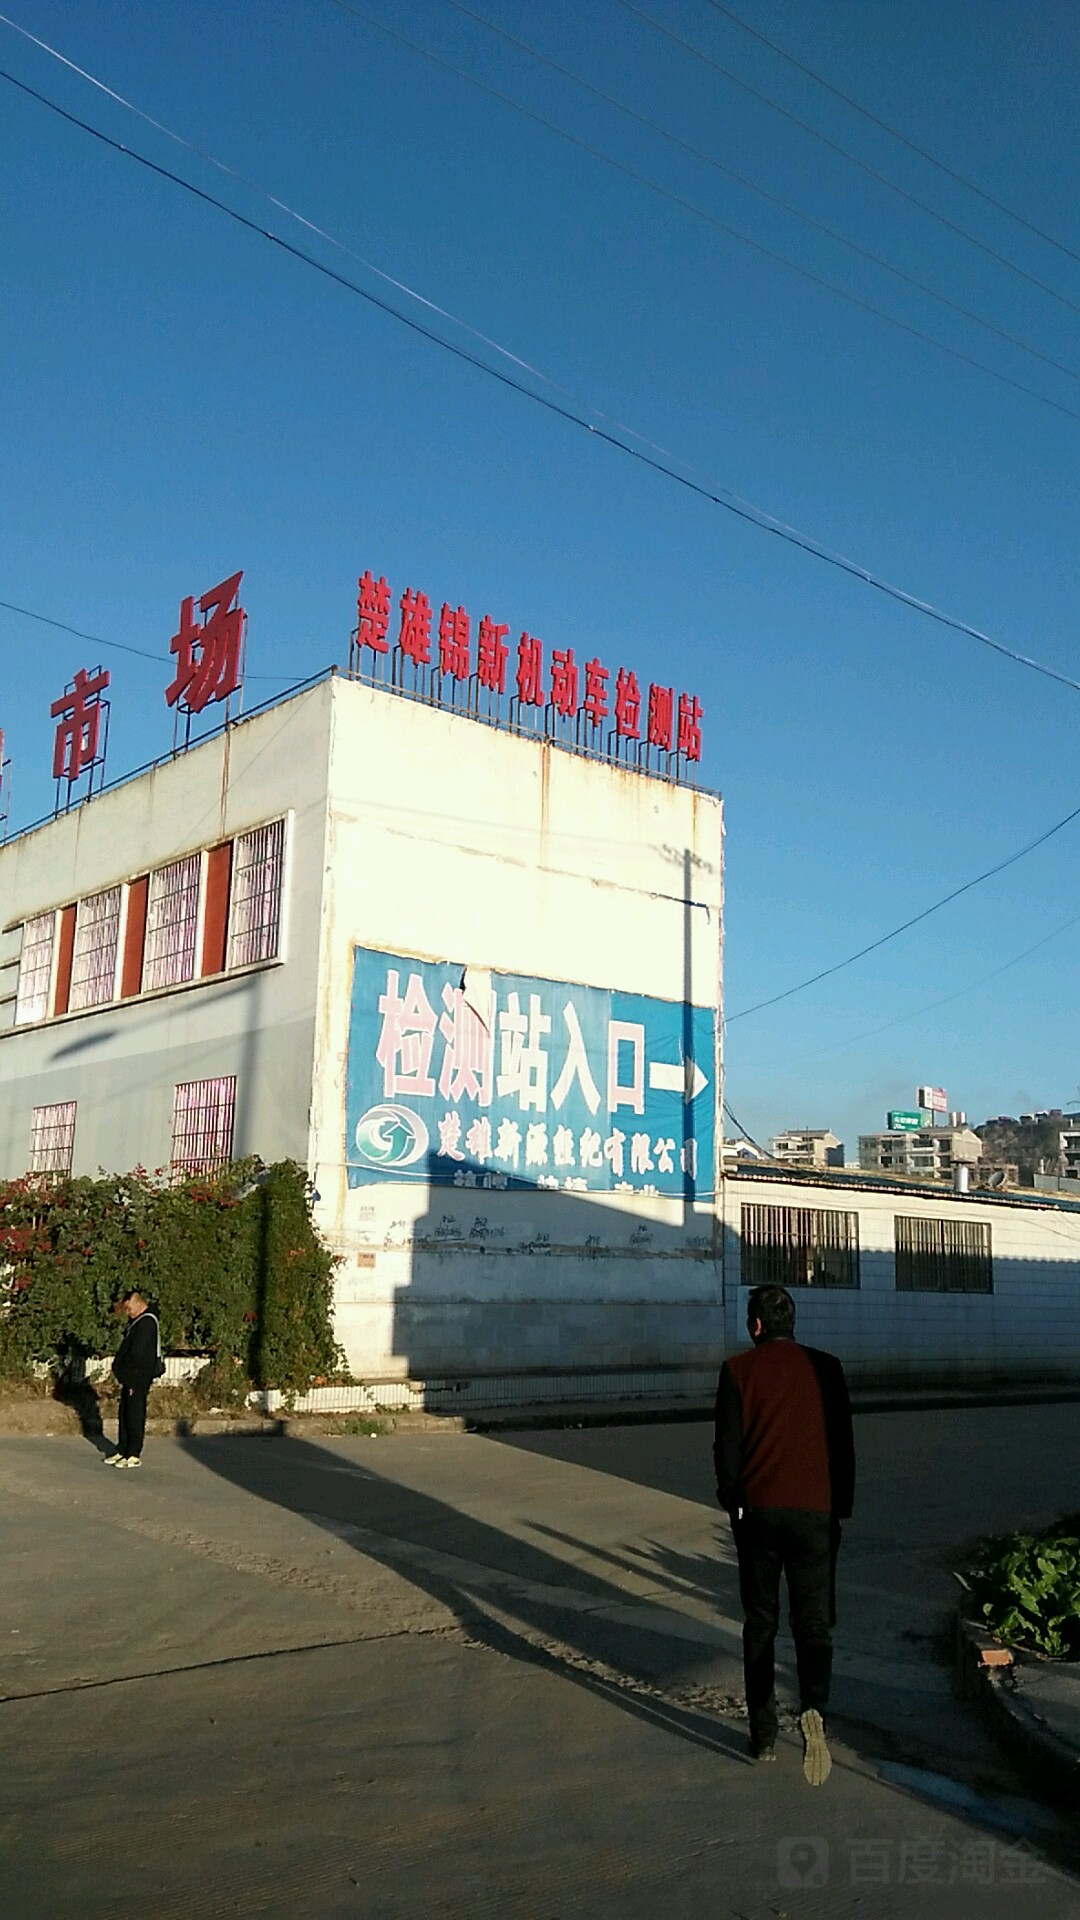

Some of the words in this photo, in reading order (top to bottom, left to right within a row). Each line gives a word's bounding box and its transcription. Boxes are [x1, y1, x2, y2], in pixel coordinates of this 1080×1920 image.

[0, 570, 243, 783] 市场
[356, 569, 704, 762] 楚雄锦新机动车检测站
[376, 969, 645, 1116] 检测站入口
